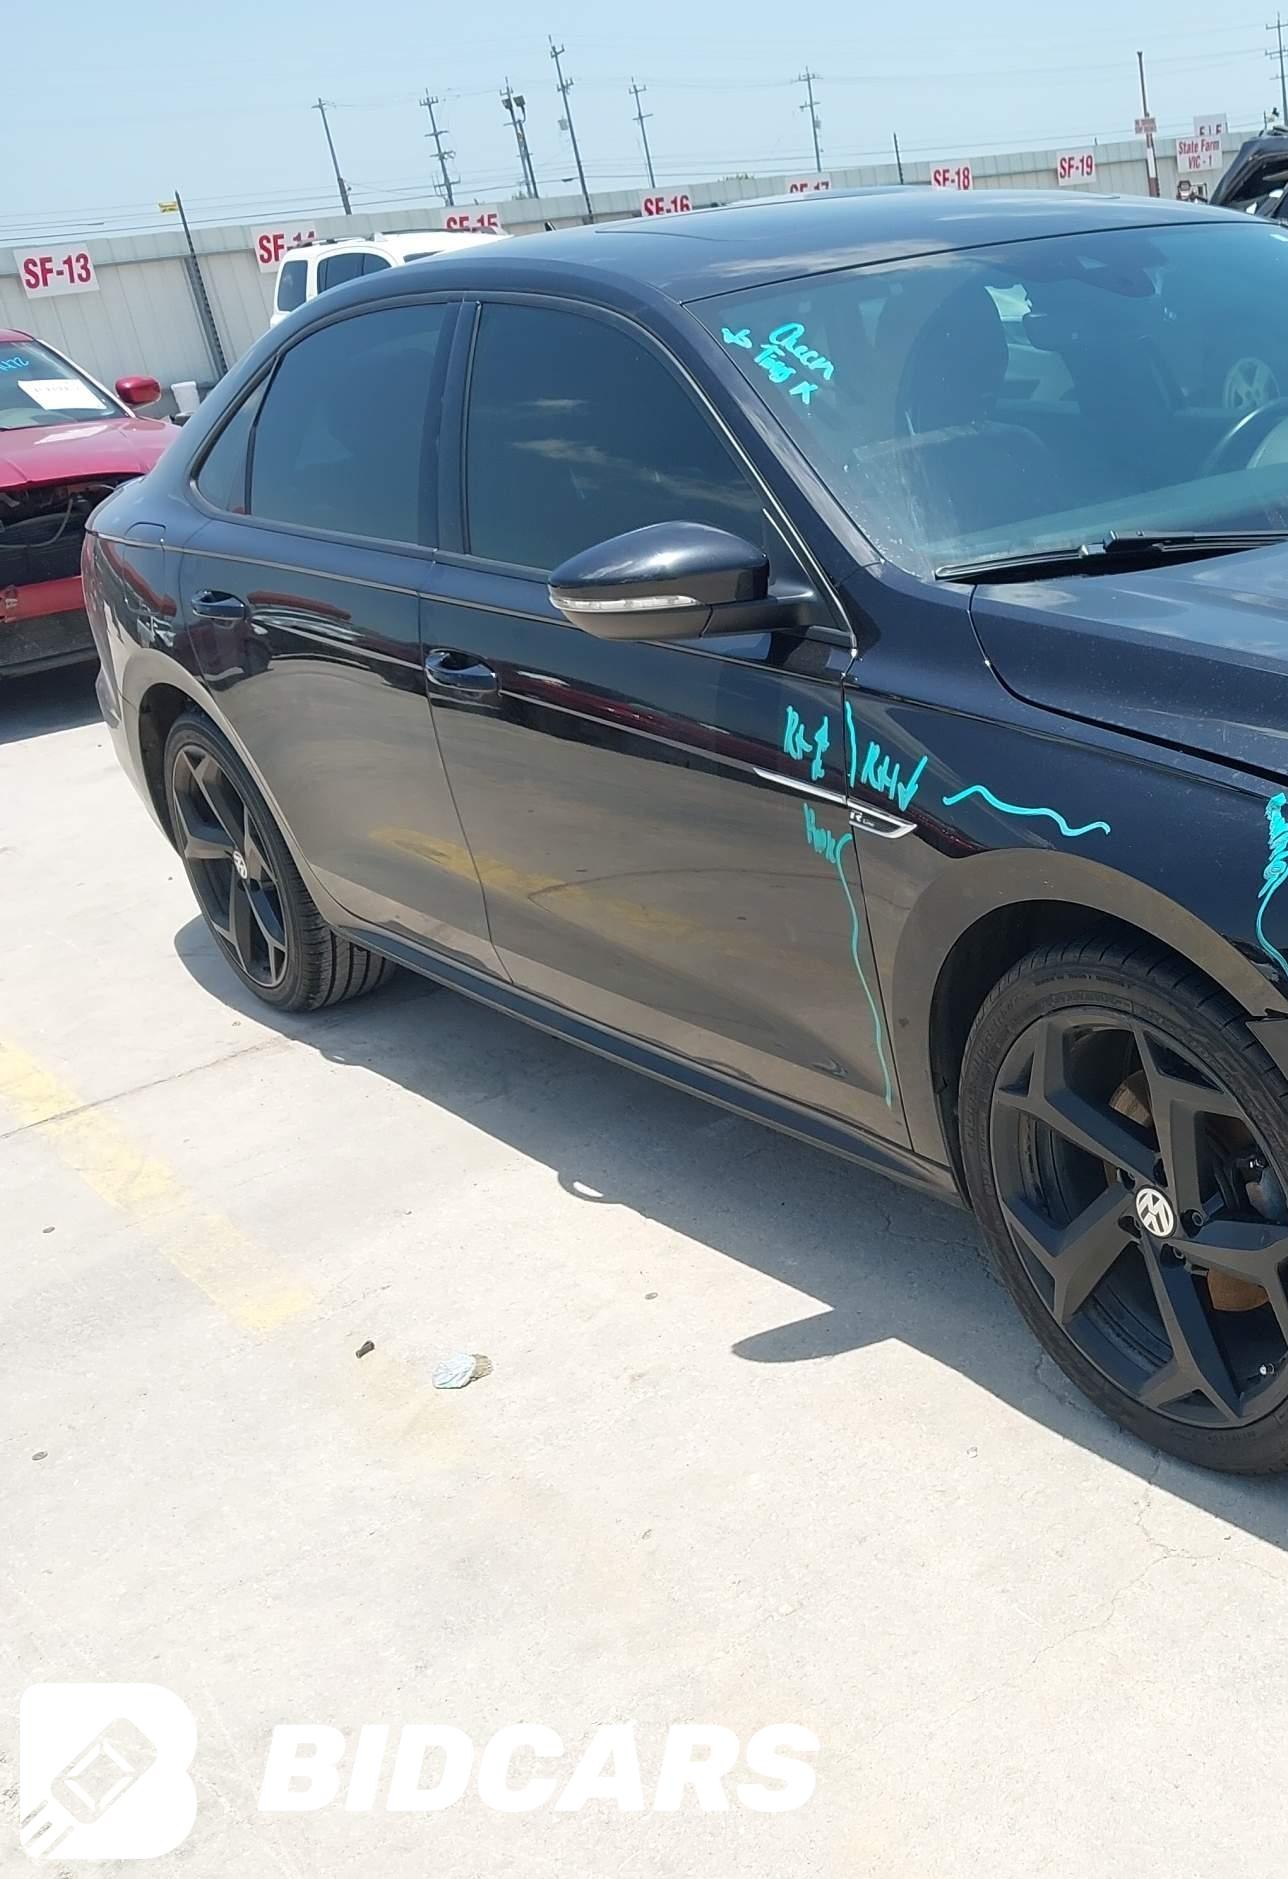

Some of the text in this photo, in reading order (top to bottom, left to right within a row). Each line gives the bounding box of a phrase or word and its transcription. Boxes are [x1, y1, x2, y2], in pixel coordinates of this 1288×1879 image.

[1178, 139, 1220, 154] State Farm
[933, 166, 970, 190] SF-18
[1059, 154, 1093, 178] SF-19
[643, 194, 691, 216] SF-16
[23, 252, 91, 289] SF-13
